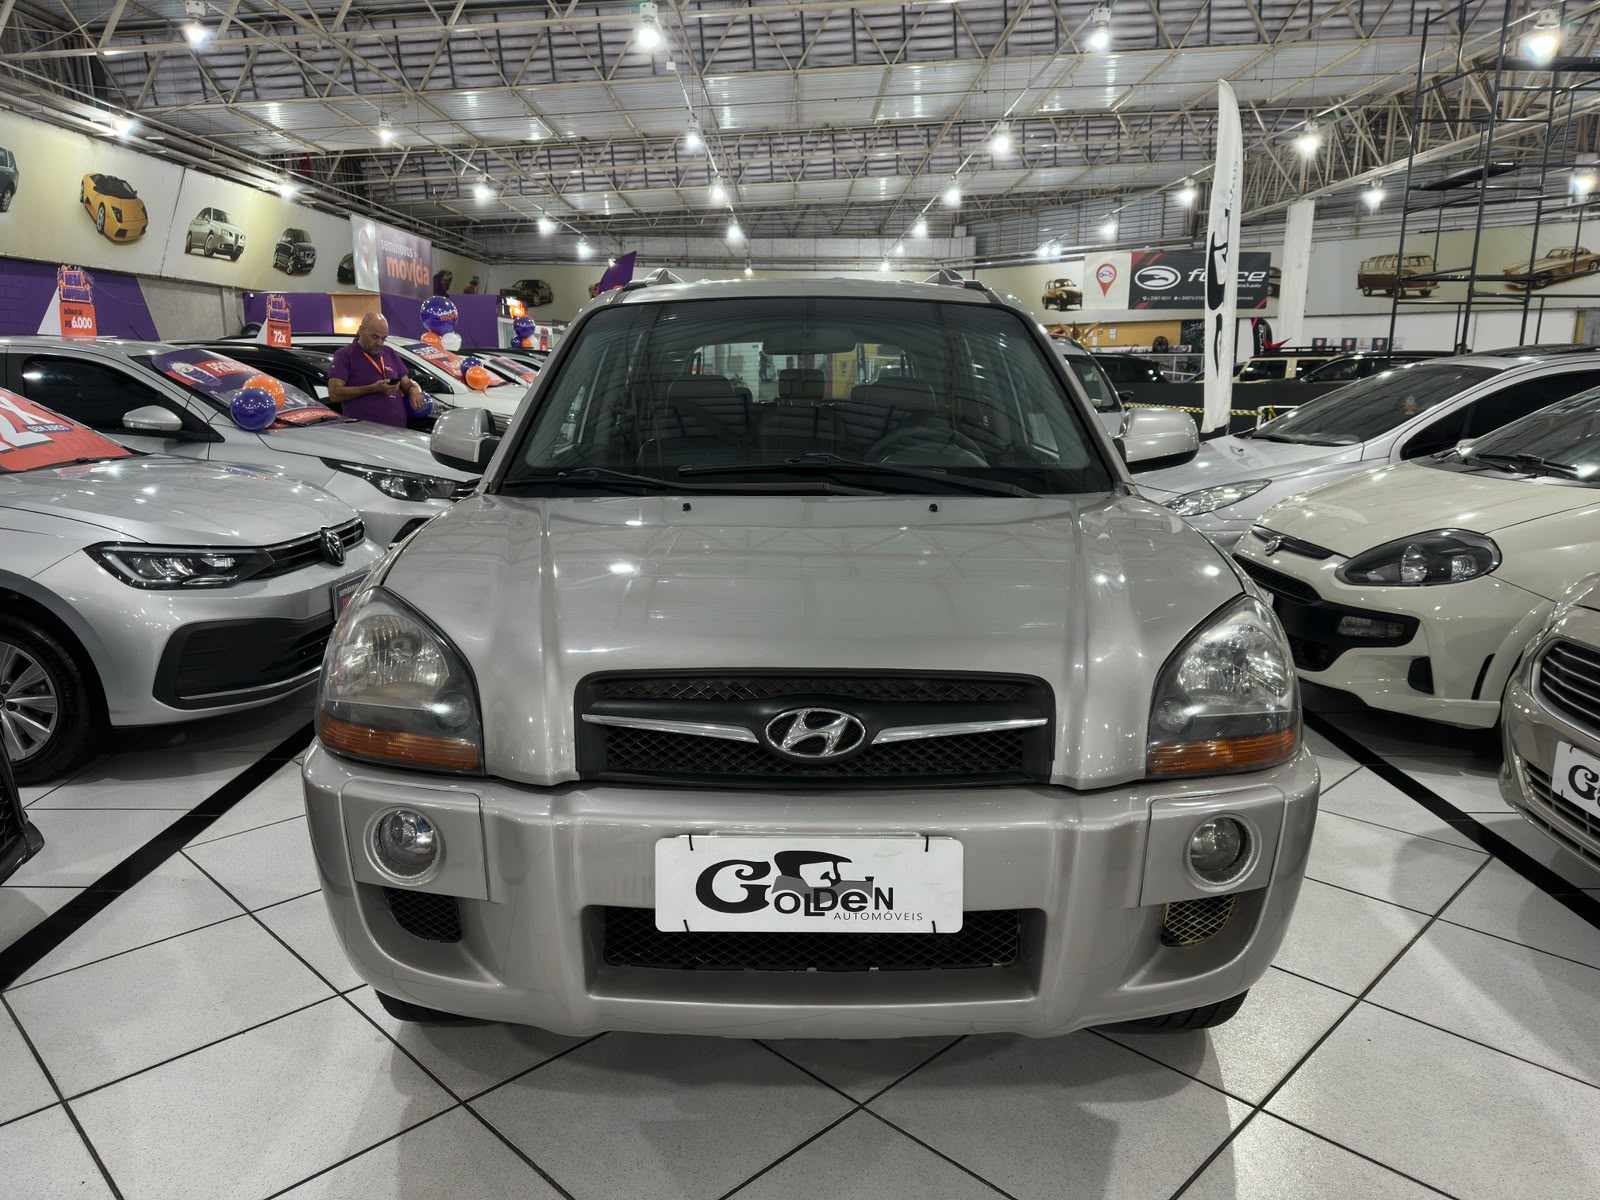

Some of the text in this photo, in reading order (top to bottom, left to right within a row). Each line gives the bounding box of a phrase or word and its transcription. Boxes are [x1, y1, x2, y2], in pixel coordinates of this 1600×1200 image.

[380, 239, 413, 258] seminovos
[386, 251, 431, 288] movida
[833, 910, 923, 921] AUTOMÓVEIS
